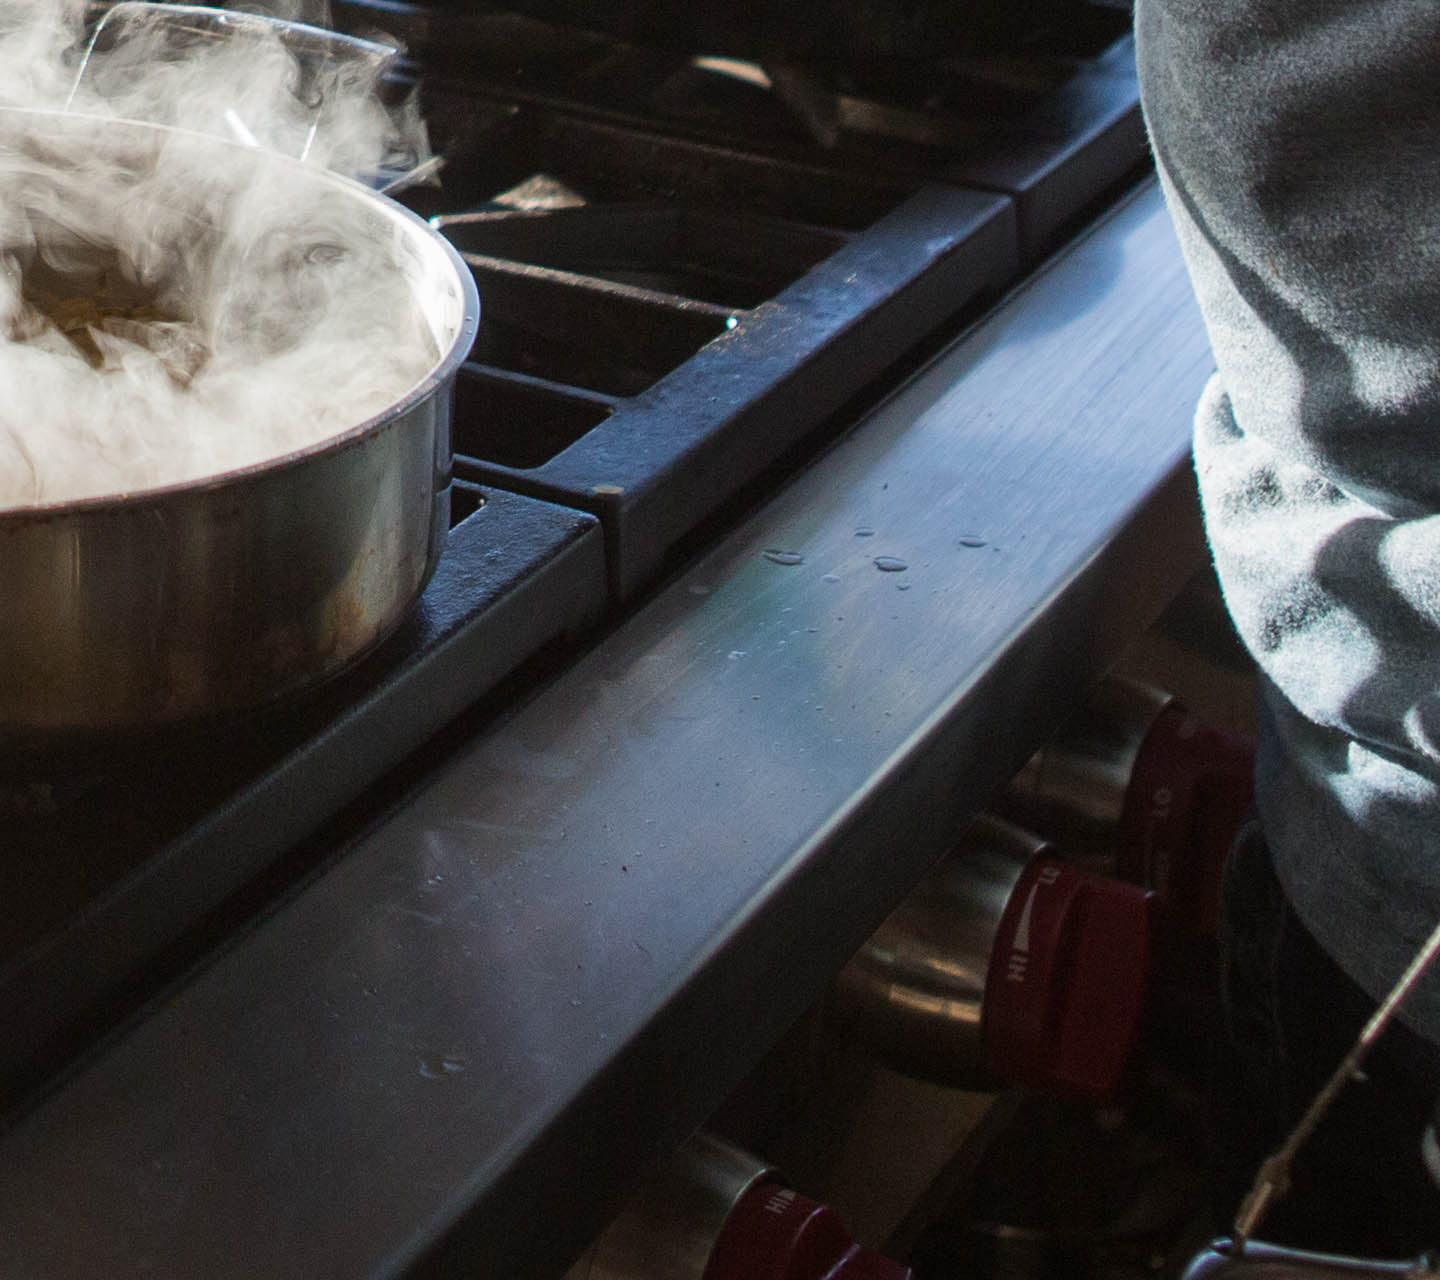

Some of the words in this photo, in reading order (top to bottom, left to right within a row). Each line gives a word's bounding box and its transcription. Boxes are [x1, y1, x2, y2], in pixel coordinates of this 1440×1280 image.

[1037, 865, 1062, 886] LO
[1006, 954, 1029, 983] HI
[764, 1196, 792, 1215] HI
